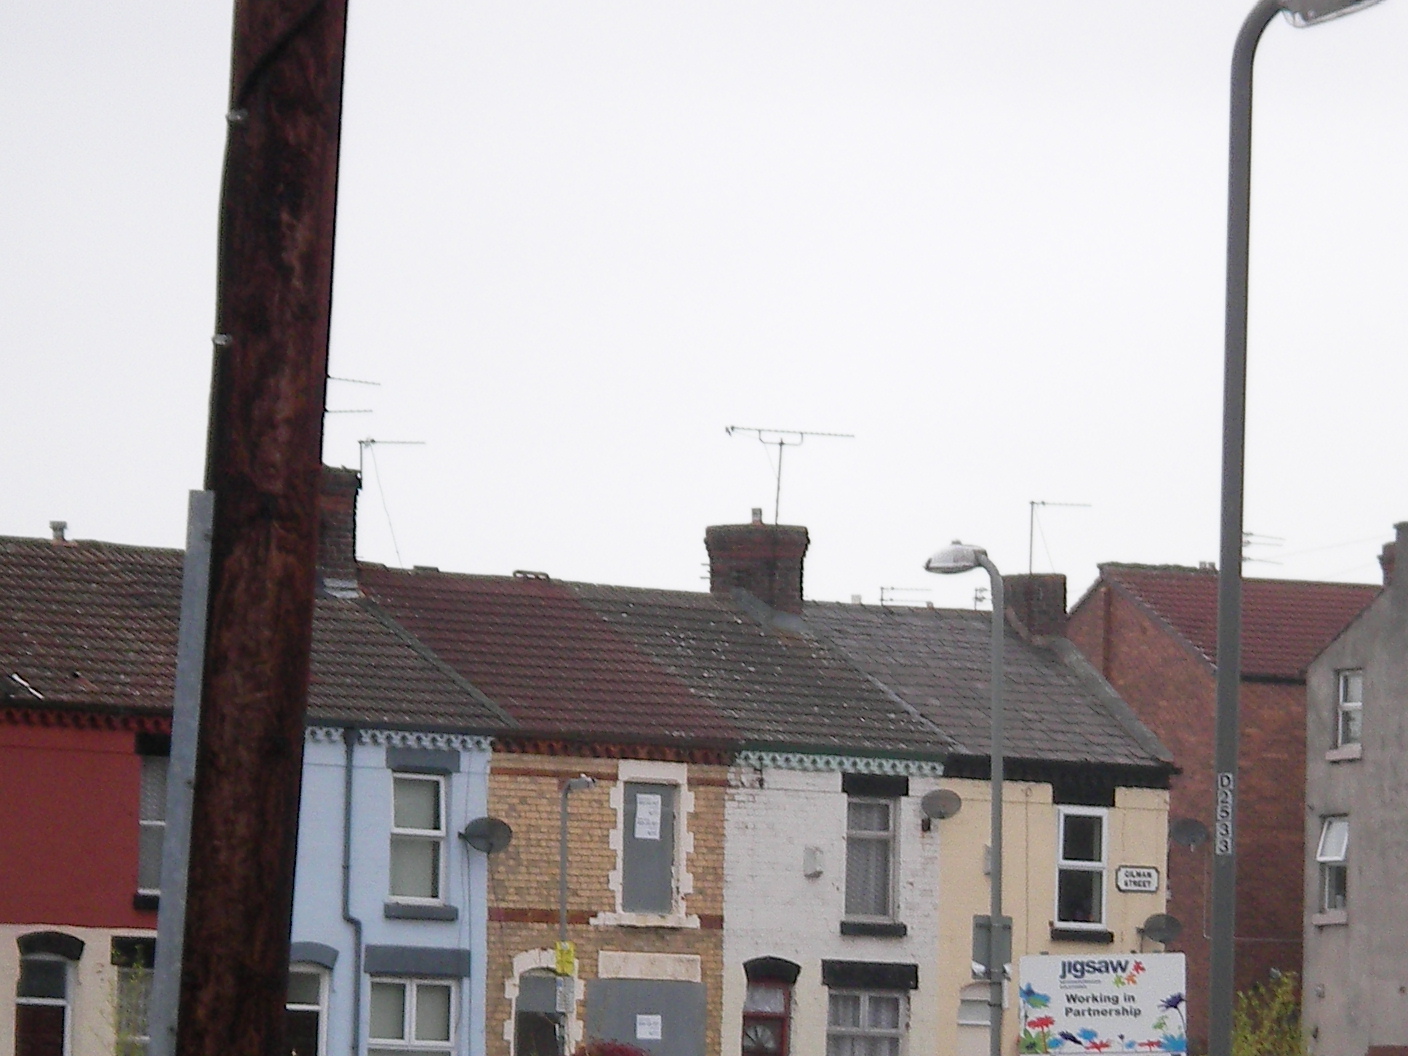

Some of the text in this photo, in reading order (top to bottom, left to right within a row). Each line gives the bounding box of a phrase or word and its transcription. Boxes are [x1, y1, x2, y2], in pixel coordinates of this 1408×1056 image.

[1124, 880, 1151, 888] STREET
[1065, 992, 1136, 1005] Working in
[1065, 1006, 1142, 1018] Partnership
